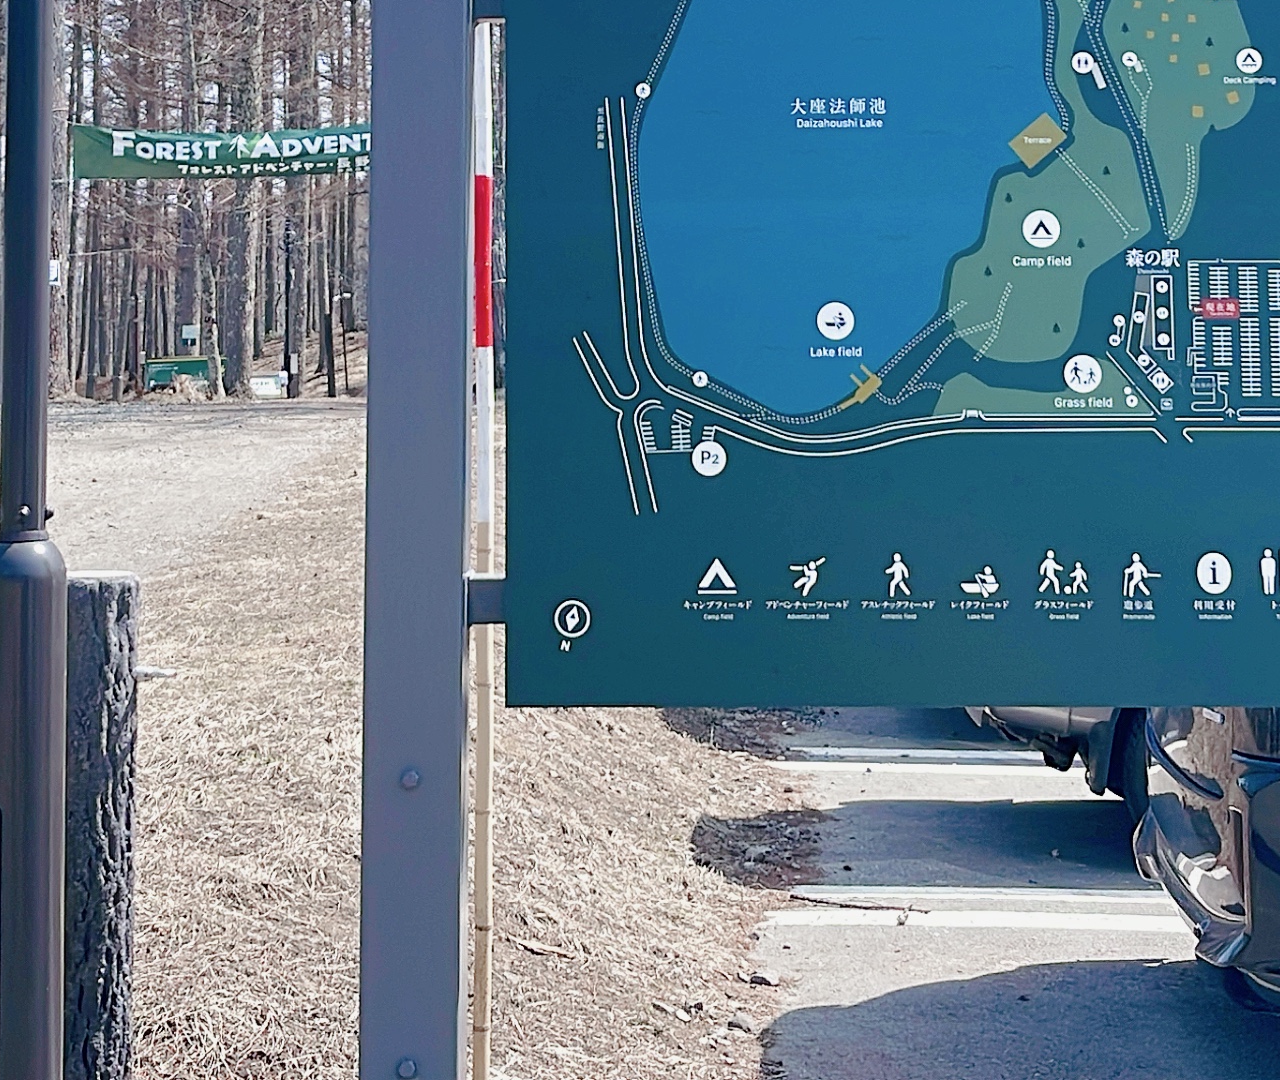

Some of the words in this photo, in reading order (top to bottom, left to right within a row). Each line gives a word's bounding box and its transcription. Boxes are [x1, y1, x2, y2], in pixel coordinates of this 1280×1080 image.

[791, 98, 886, 114] 大座法師池
[797, 118, 857, 128] Daizahoushi
[860, 118, 883, 127] Lake
[111, 131, 222, 162] FOREST
[1013, 256, 1045, 268] Camp
[1047, 256, 1071, 266] field
[1125, 248, 1181, 268] 森の駅
[810, 347, 835, 357] Lake
[838, 347, 862, 357] field
[1055, 397, 1085, 407] Grass
[1088, 397, 1113, 407] field
[683, 600, 752, 610] キャンプフィールド
[765, 600, 849, 610] アドベンチャーフィールド
[950, 600, 1009, 610] レイクフィールド
[1034, 600, 1094, 610] グラスフィールド
[1193, 599, 1236, 611] 利用受付
[560, 639, 571, 652] N
